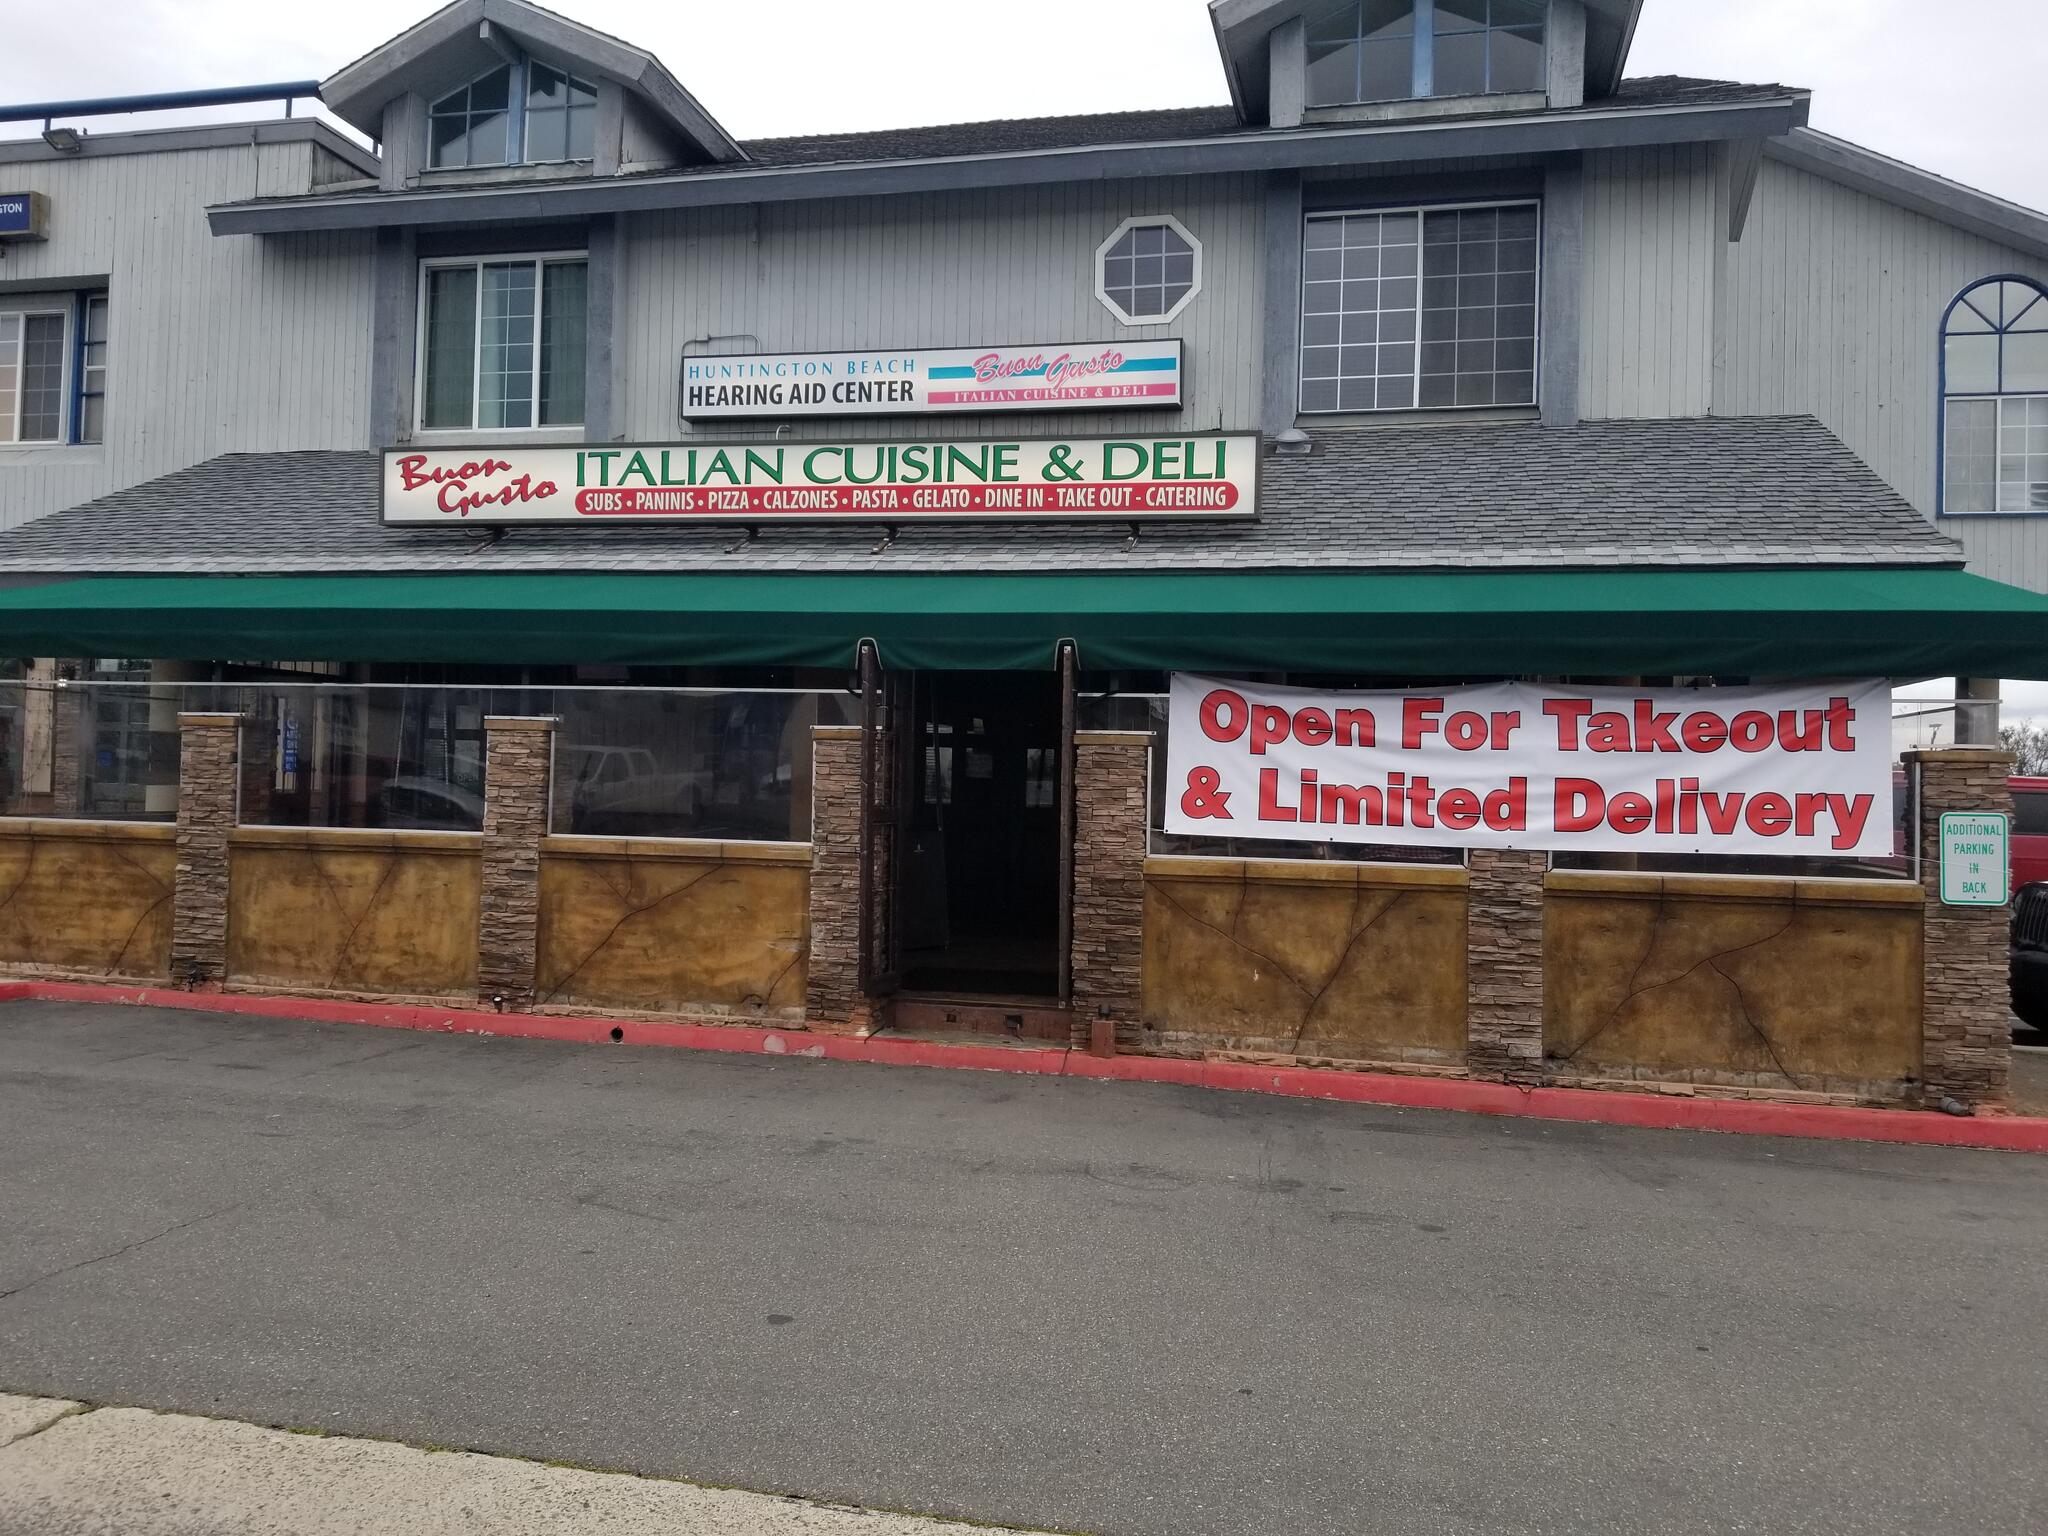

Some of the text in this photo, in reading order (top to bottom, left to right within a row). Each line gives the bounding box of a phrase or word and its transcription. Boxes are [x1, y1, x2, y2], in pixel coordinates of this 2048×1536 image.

[689, 359, 915, 379] HUNTINGTON BEACH
[972, 349, 1123, 392] Buon Gusto
[689, 380, 914, 407] HEARING AID CENTER
[953, 385, 1147, 402] ITALIAN CUISINE & DELI
[397, 454, 512, 491] Buon
[576, 440, 1227, 487] ITALIAN CUISINE & DELI
[437, 473, 558, 517] Gusto
[585, 486, 1227, 511] SUBS PANINIS PIZZA CALZONES PASTA GELATO DINE IN TAKE OUT CATERING
[1198, 689, 1856, 755] Open For Takeout
[1180, 766, 1875, 851] & Limited Delivery
[1946, 824, 2002, 836] ADDITIONAL
[1954, 843, 1994, 855] PARKING
[1969, 863, 1979, 874] IN
[1962, 882, 1987, 893] BACK
